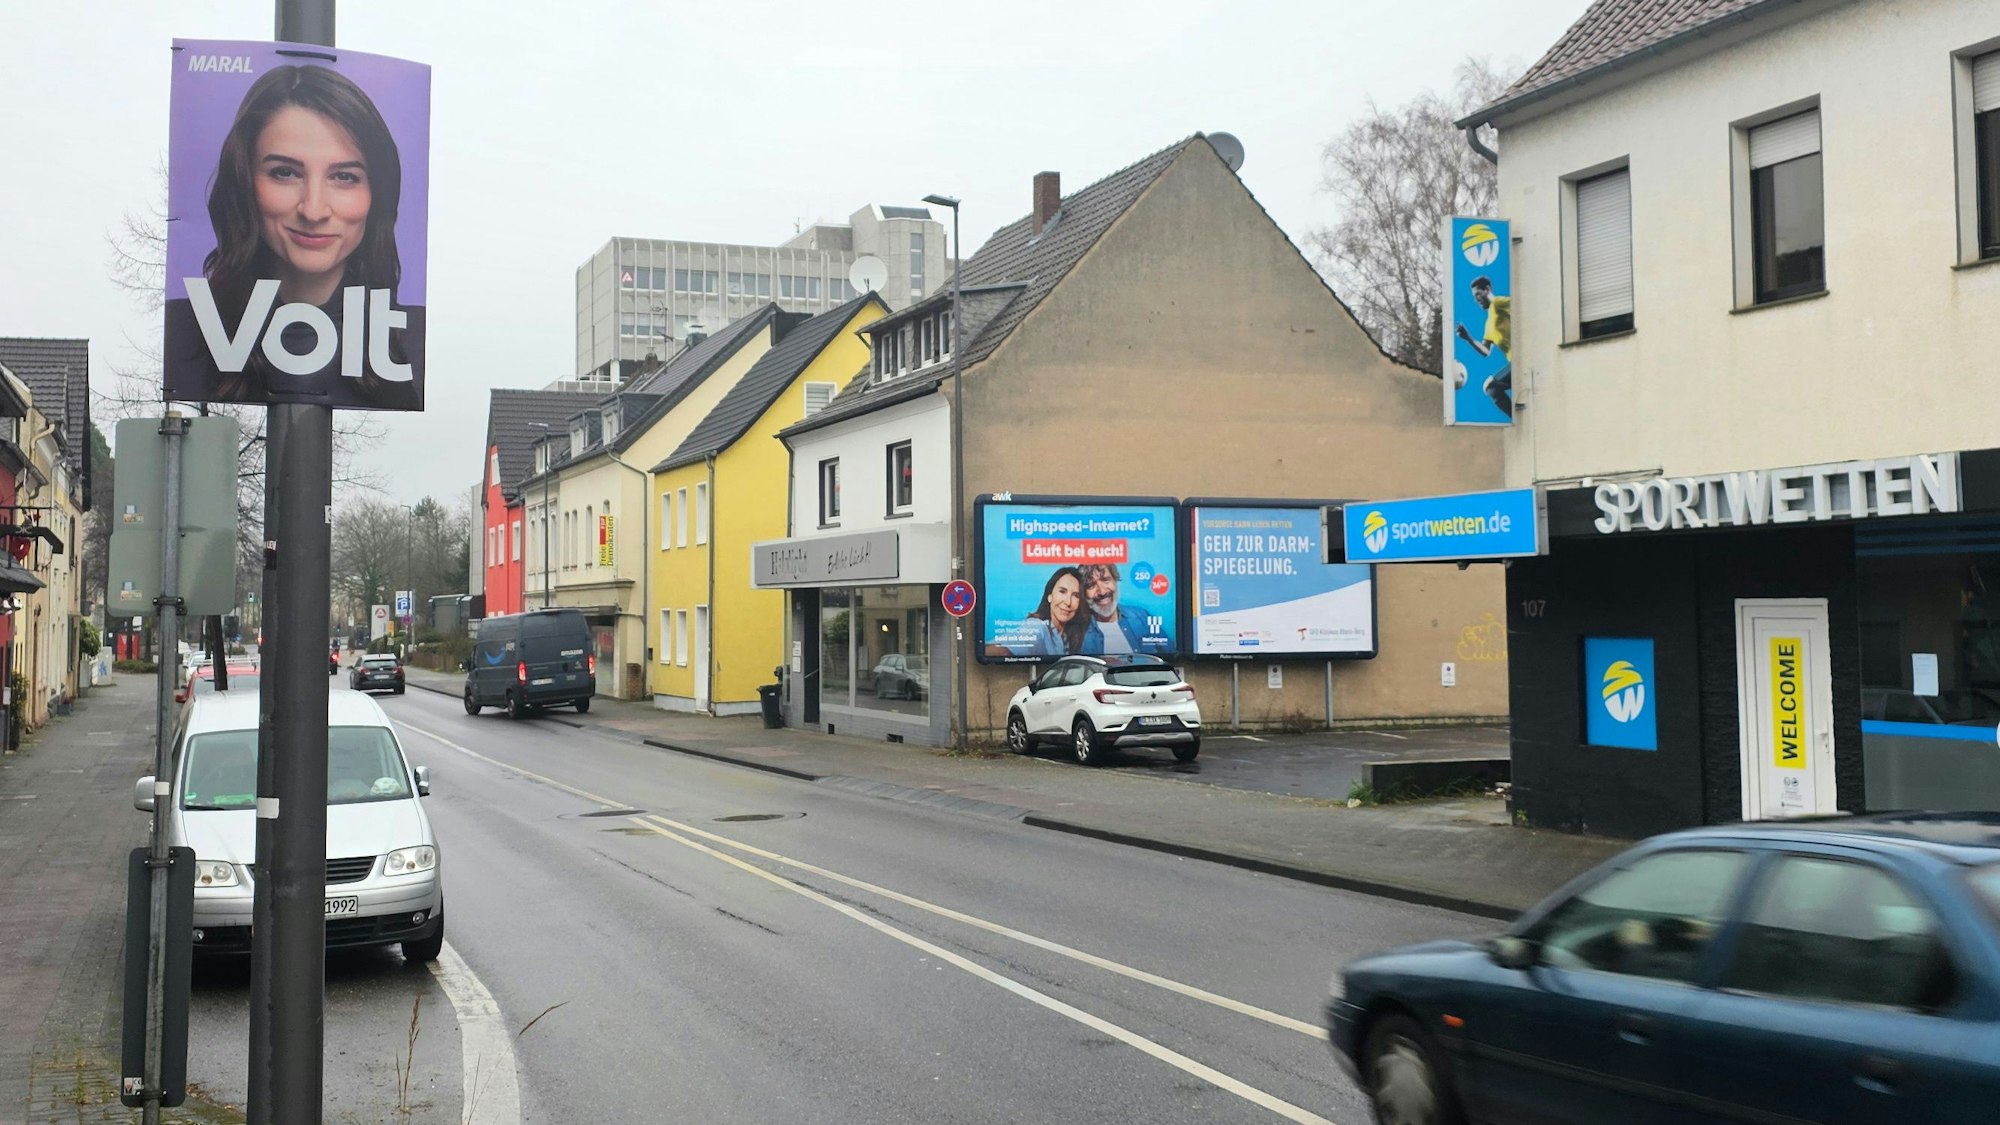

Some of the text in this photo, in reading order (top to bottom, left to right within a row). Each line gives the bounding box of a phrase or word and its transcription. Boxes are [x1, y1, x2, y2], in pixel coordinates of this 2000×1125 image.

[188, 55, 253, 73] MARAL
[183, 277, 413, 382] Volt
[1594, 452, 1962, 534] SPORTWETTEN
[1010, 518, 1150, 535] Highspeed-Internet?
[1392, 510, 1512, 544] sportwetten.de
[1026, 543, 1124, 557] Läuft bei euch!
[1204, 535, 1316, 552] GEH ZUR DARM-
[1204, 558, 1297, 575] SPIEGELUNG.
[1134, 571, 1151, 581] 250
[1521, 600, 1546, 617] 107
[1778, 644, 1798, 760] WELCOME
[325, 899, 356, 913] 1992
